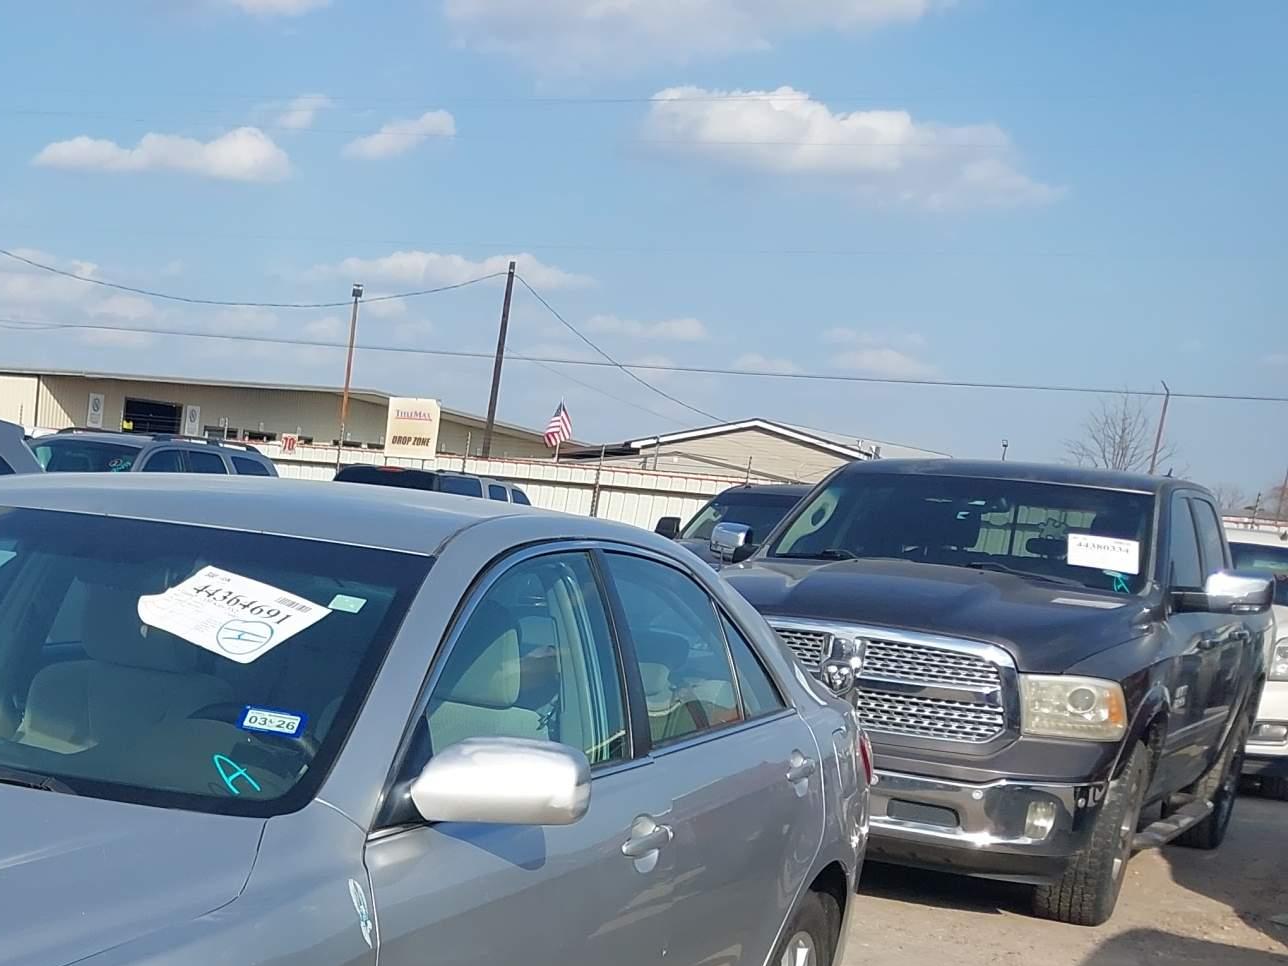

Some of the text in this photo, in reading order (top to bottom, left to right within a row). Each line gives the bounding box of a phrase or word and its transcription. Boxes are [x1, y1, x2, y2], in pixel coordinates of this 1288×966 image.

[392, 435, 431, 447] DROP ZONE
[193, 584, 293, 625] 44364691
[248, 715, 268, 727] 03
[276, 719, 297, 731] 26
[214, 754, 260, 794] A
